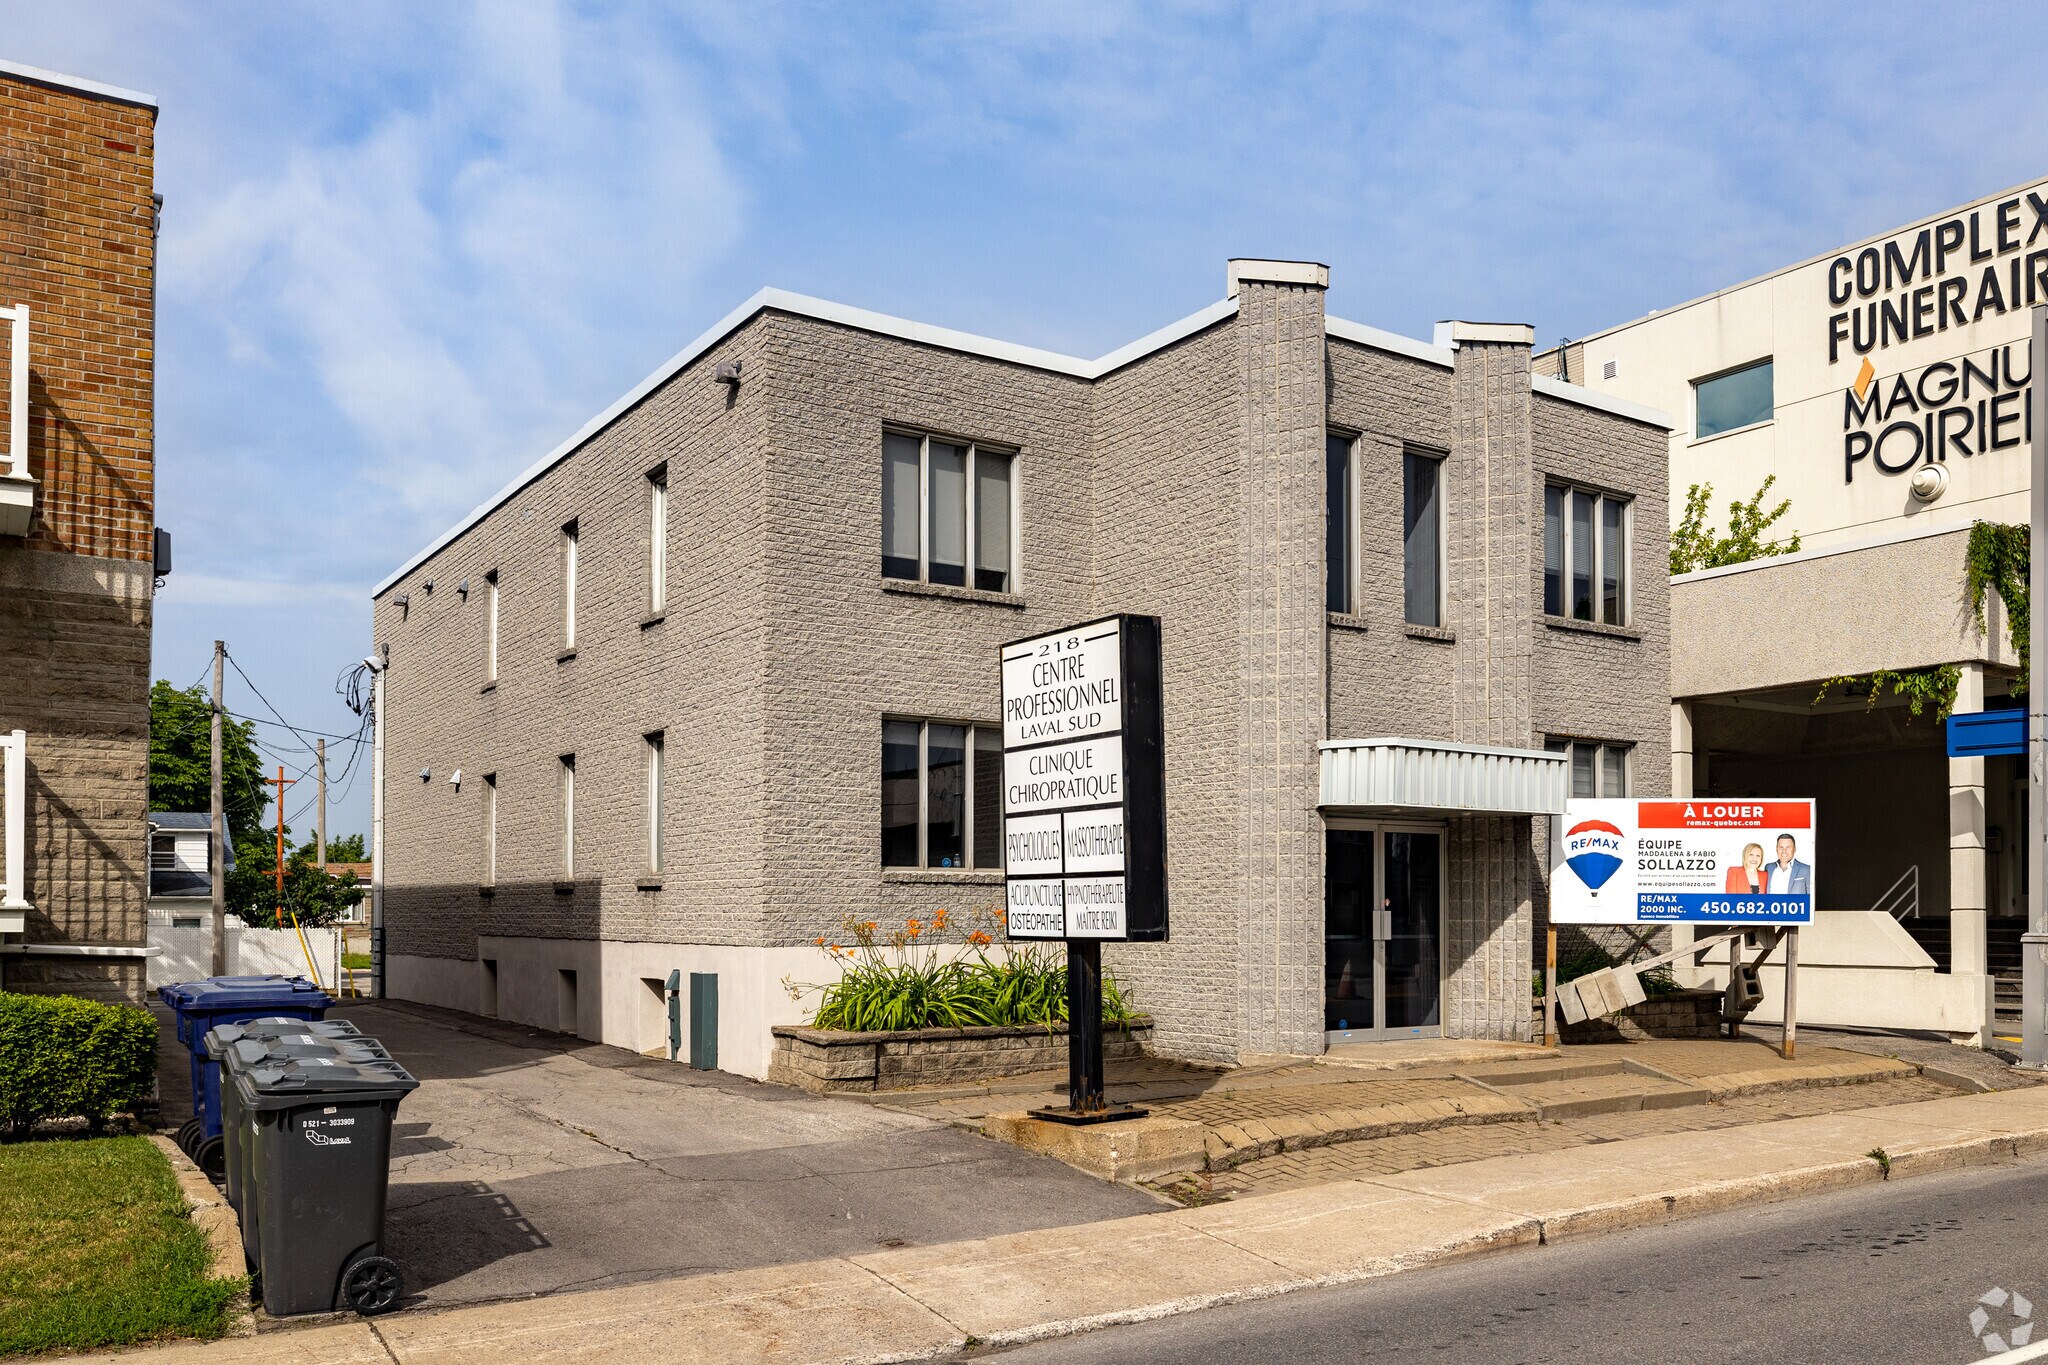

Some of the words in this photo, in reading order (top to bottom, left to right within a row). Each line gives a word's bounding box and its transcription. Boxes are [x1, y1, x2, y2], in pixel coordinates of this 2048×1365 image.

[1845, 388, 2032, 483] POIRIE
[1038, 637, 1080, 657] 218
[1032, 654, 1085, 688] CENTRE
[1007, 678, 1118, 722] PROFESSIONNEL
[1021, 719, 1064, 740] LAVAL
[1068, 712, 1101, 732] SUD
[1029, 749, 1093, 775] CLINIQUE
[1009, 773, 1118, 805] CHIROPRATIQUE
[1684, 804, 1696, 818] À
[1703, 806, 1764, 818] LOUER
[1008, 830, 1060, 862] PSYCHOLOGUES
[1067, 824, 1123, 857] MASSOTHERAPIE
[1571, 838, 1618, 850] RE/MAX
[1638, 838, 1682, 850] ÉQUIPE
[1638, 859, 1716, 870] SOLLAZZO
[1010, 884, 1062, 906] ACUPUNCTURE
[1066, 879, 1124, 904] HYPNOTHÉRAPEUTE
[1640, 894, 1677, 903] RE/MAX
[1010, 909, 1062, 931] OSTÉOPATHIE
[1076, 906, 1100, 930] MAÎTRE
[1101, 911, 1118, 930] REIKI
[1700, 902, 1804, 914] 450.682.0101
